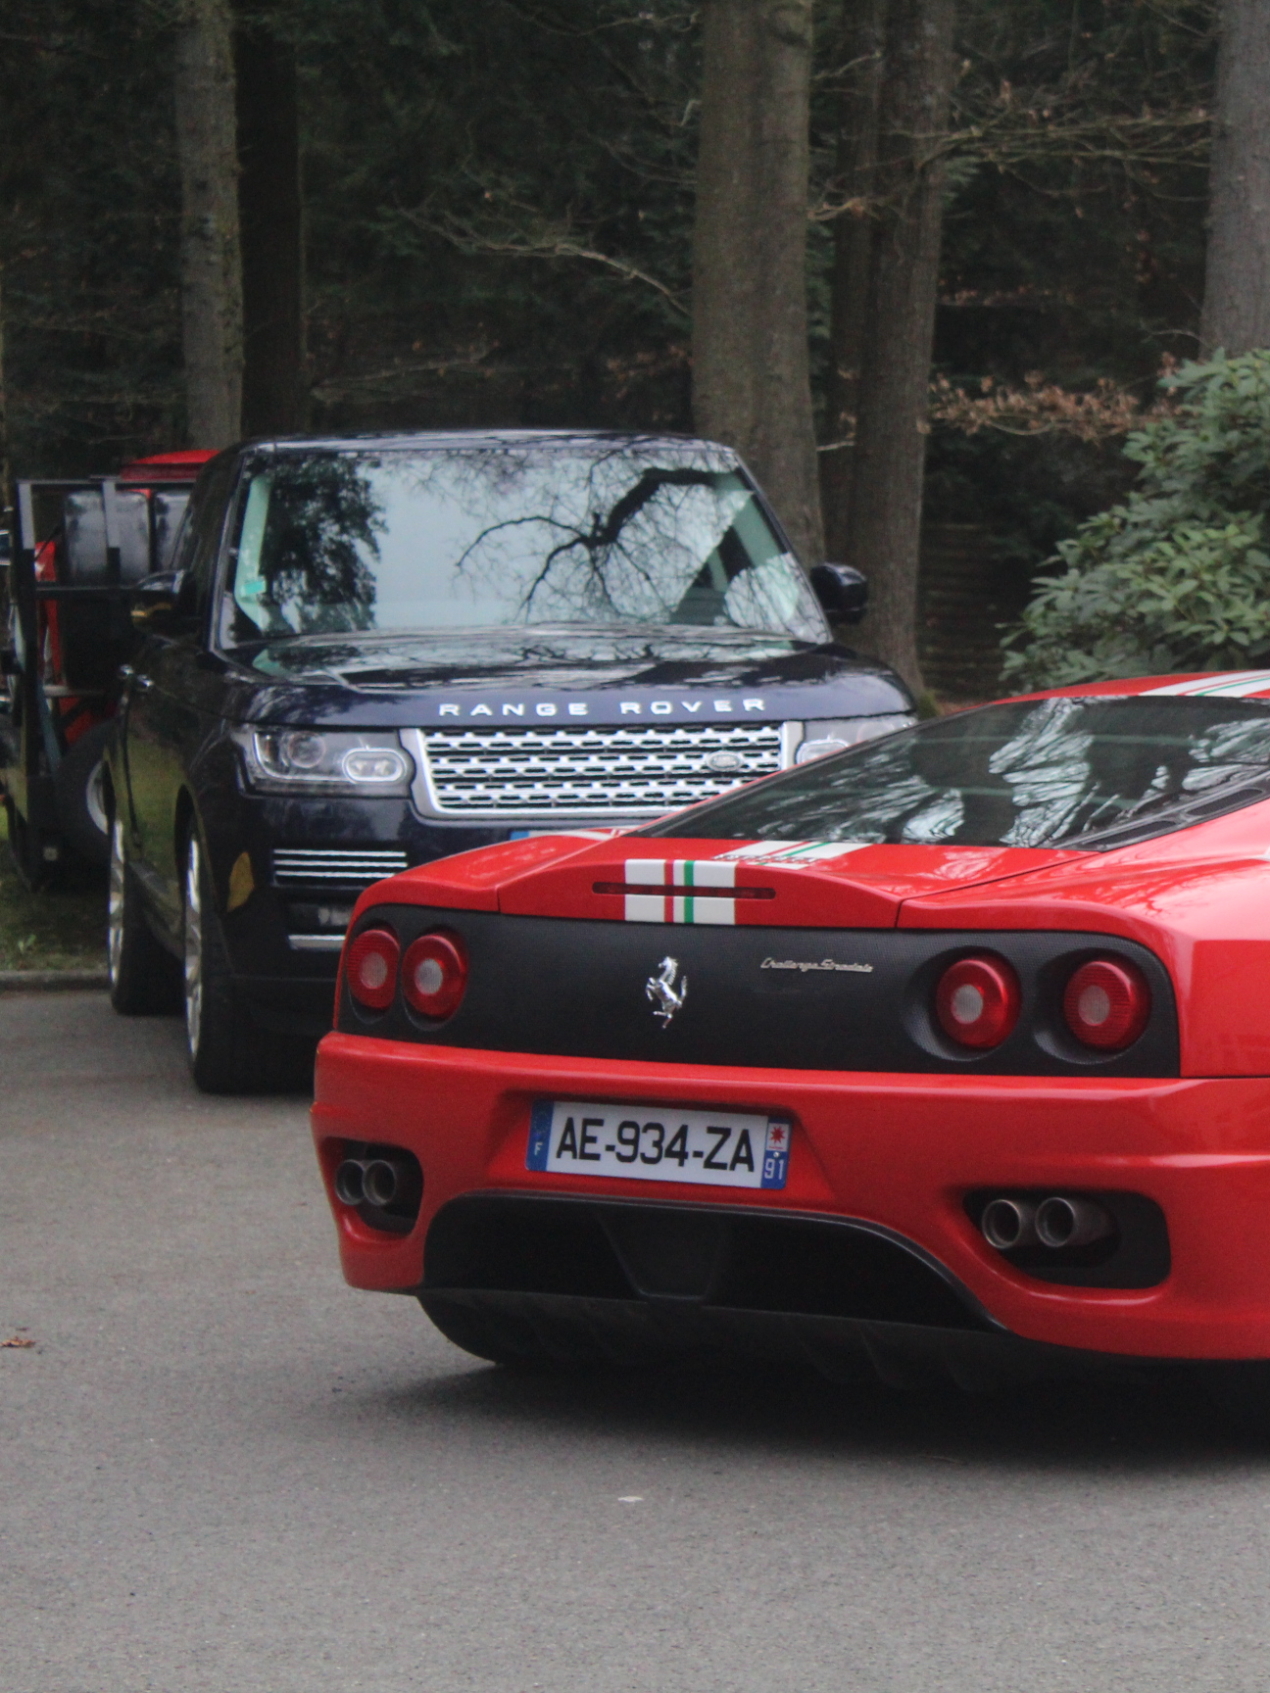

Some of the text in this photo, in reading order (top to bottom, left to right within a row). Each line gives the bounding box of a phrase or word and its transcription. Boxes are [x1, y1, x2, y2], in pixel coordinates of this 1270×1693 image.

[439, 698, 765, 717] RANGE ROVER
[534, 1142, 543, 1156] F
[556, 1117, 755, 1173] AE-934-ZA
[764, 1158, 785, 1180] 91
